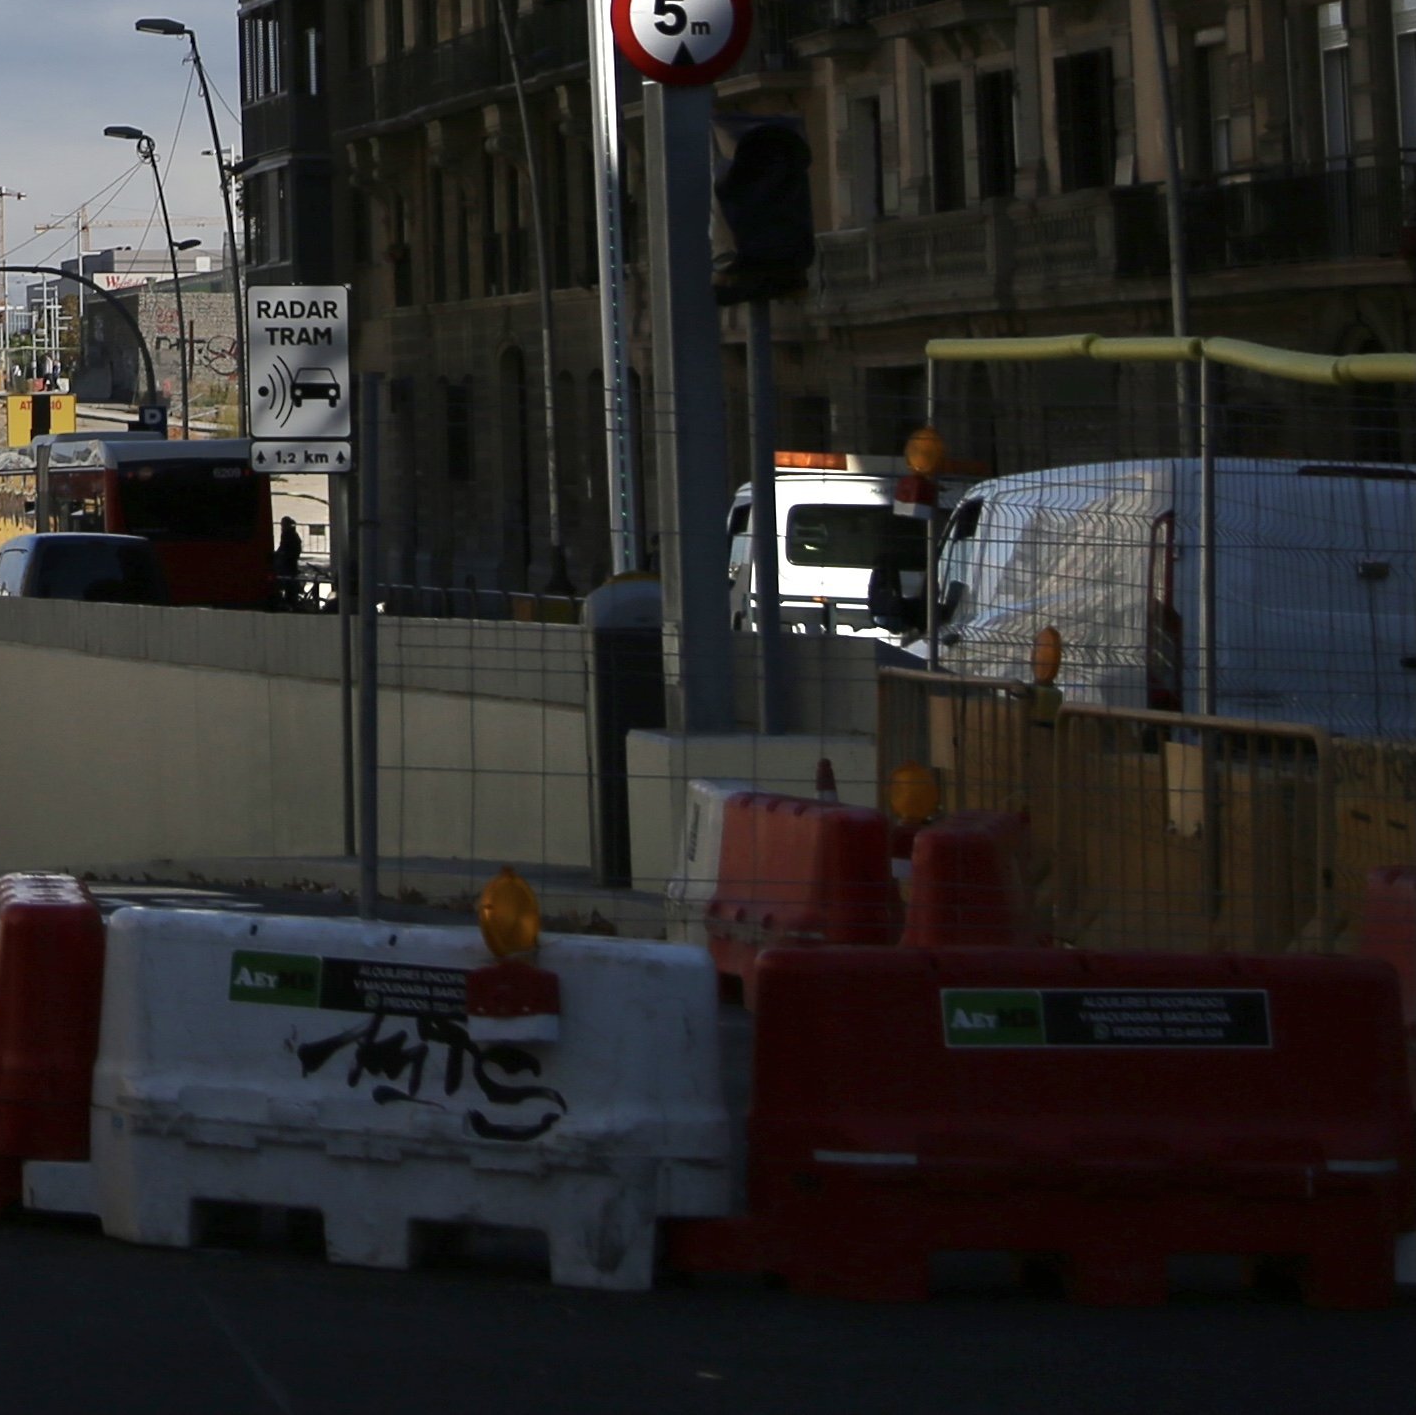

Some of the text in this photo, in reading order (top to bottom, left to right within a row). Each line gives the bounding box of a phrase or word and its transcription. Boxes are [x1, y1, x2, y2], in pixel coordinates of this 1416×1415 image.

[256, 300, 339, 319] RADAR
[265, 327, 332, 346] TRAM
[304, 450, 329, 464] km
